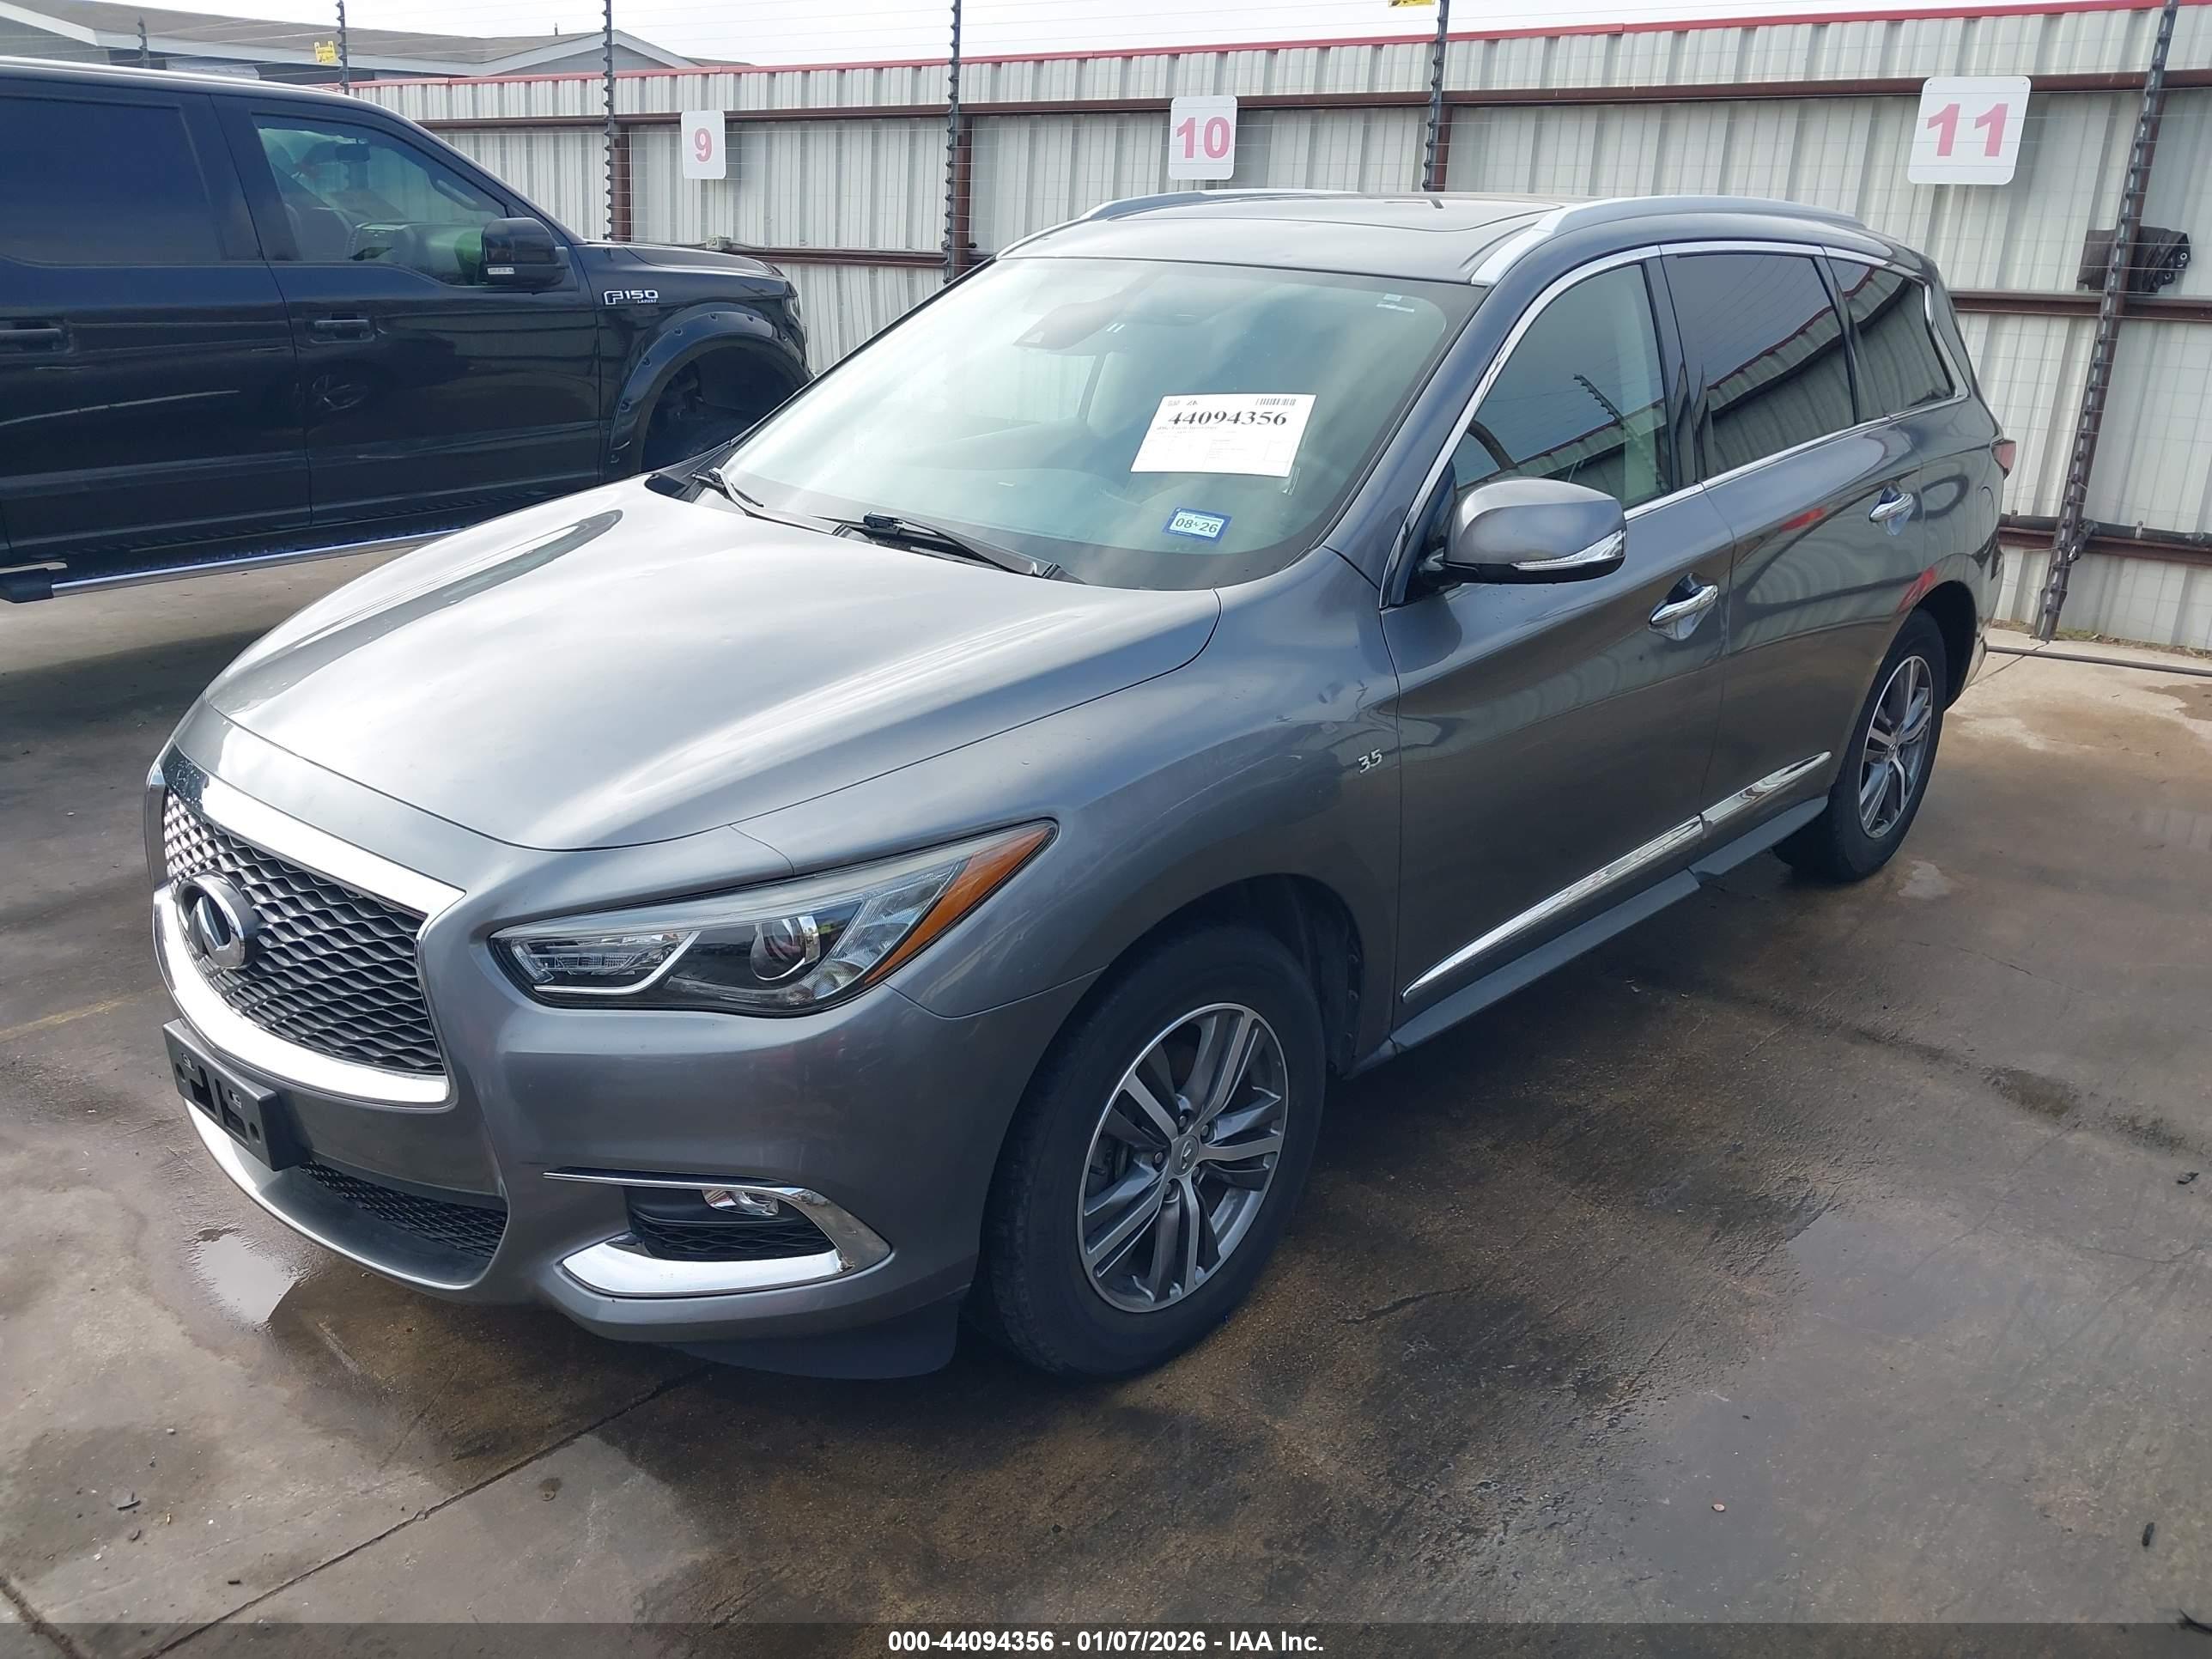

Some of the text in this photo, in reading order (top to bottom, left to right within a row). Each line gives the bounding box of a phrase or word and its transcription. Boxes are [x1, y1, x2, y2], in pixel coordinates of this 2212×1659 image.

[695, 128, 712, 162] 9
[1176, 116, 1231, 159] 10
[1927, 103, 2008, 157] 11
[1168, 410, 1288, 426] 44094356
